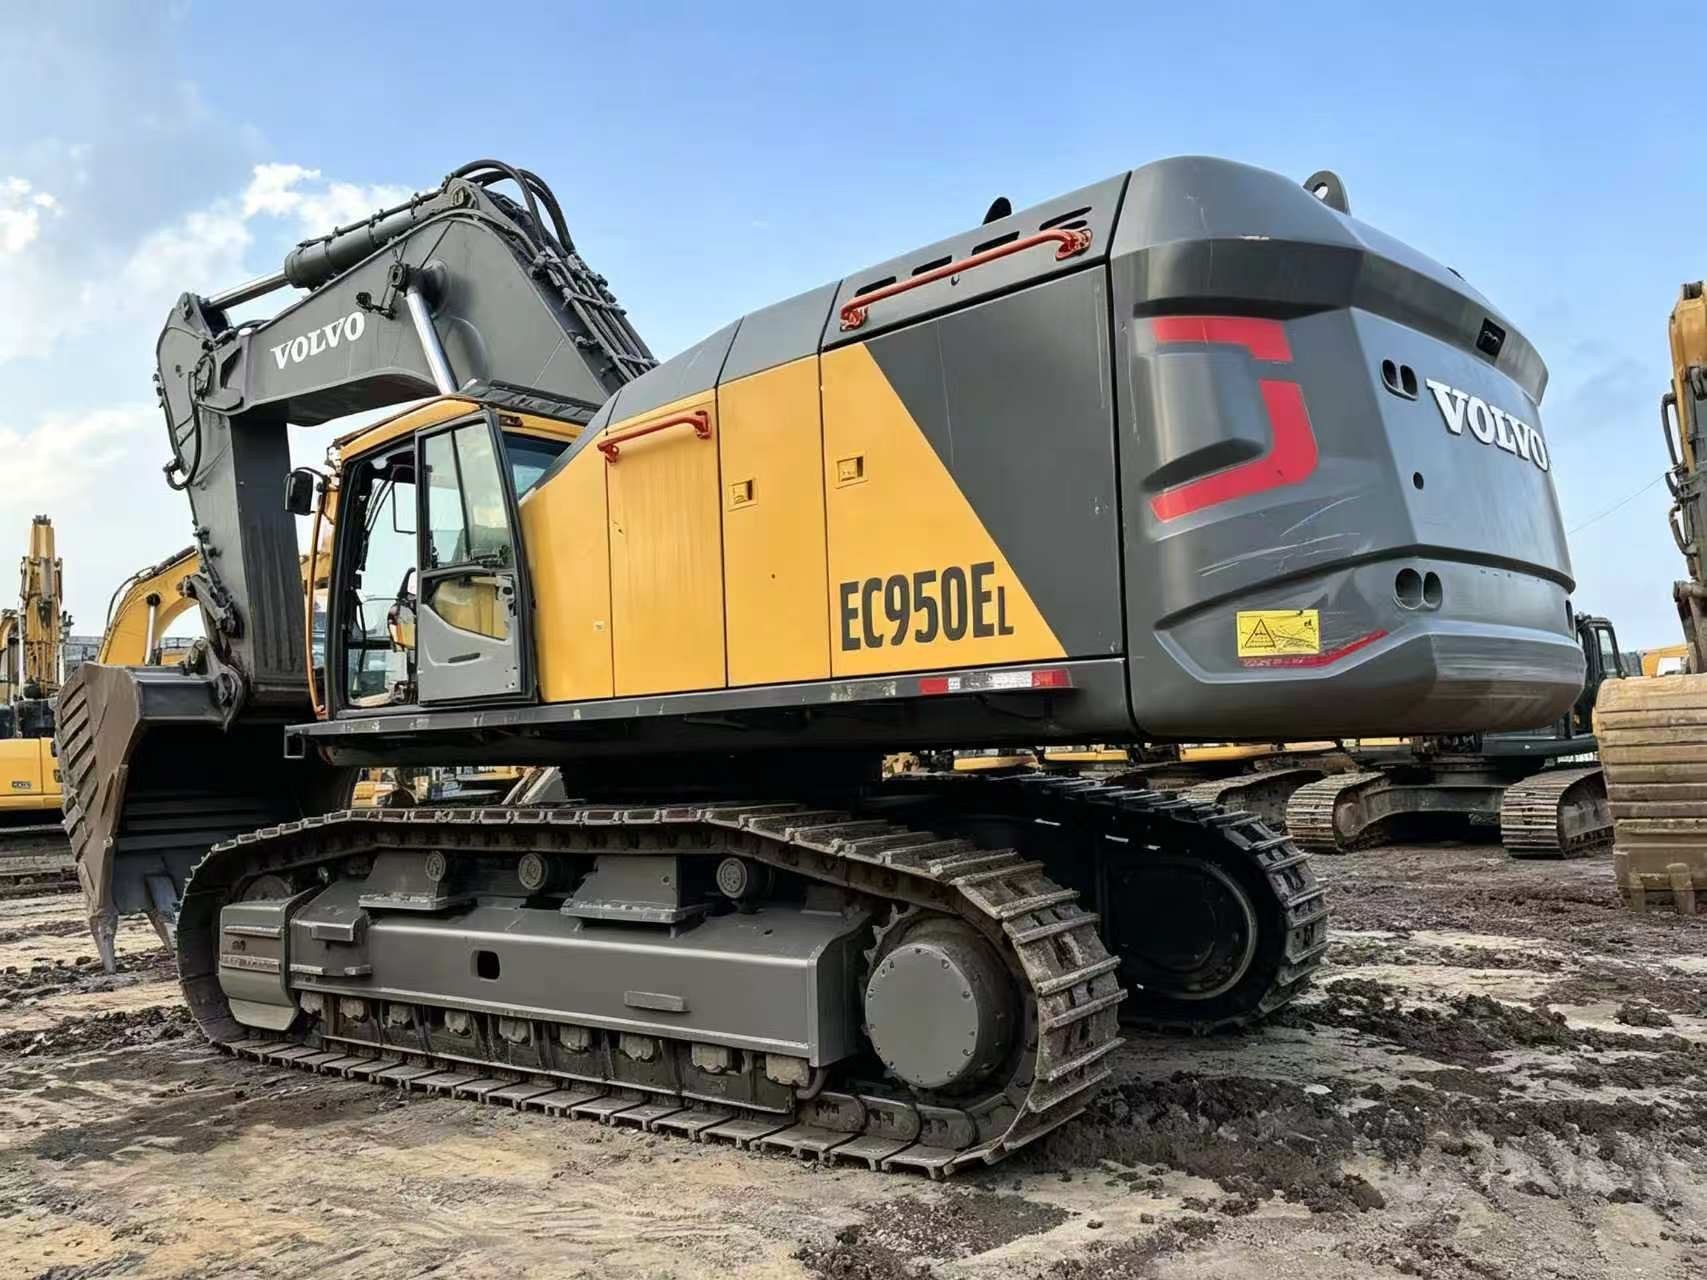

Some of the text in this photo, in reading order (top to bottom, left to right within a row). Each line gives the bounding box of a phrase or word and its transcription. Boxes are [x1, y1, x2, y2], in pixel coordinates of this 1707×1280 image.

[270, 311, 365, 370] VOLVO
[1426, 378, 1549, 472] VOLVO
[840, 561, 1014, 651] EC950EL
